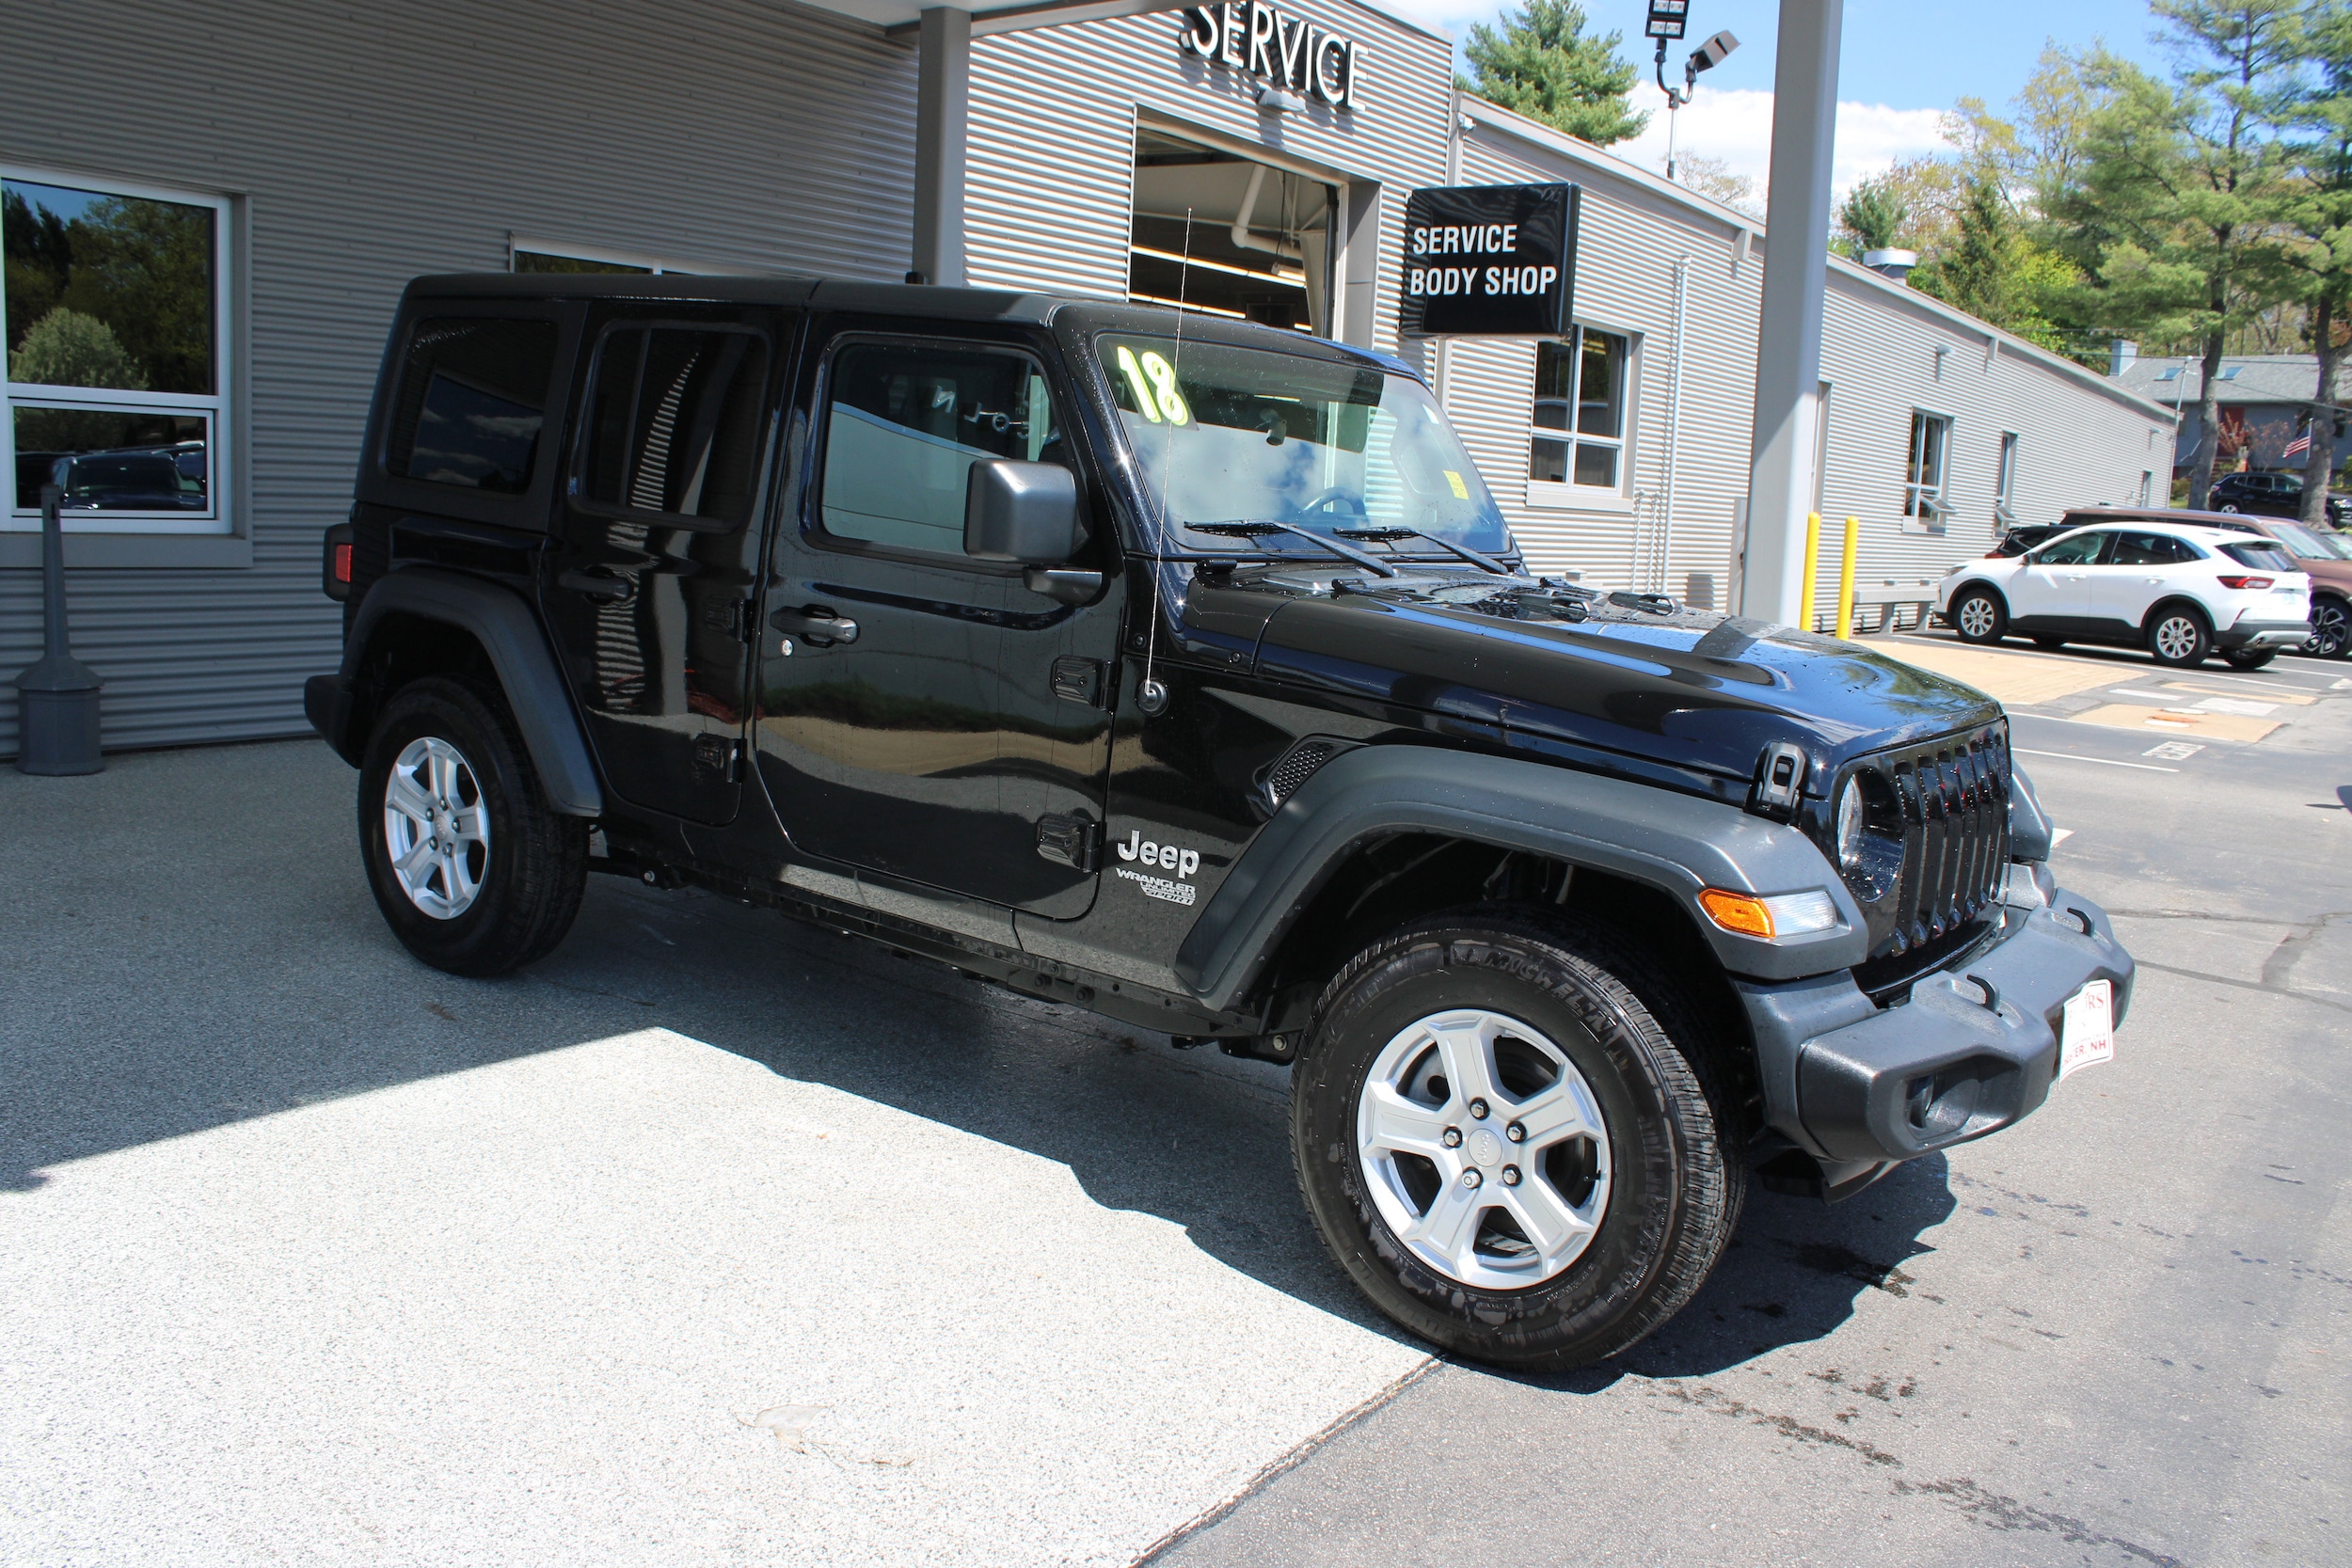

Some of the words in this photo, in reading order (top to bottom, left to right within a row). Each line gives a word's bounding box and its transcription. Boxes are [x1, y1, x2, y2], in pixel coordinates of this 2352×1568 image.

[1185, 1, 1369, 112] SERVICE
[1413, 224, 1518, 255] SERVICE
[1409, 267, 1478, 296] BODY
[1485, 265, 1557, 295] SHOP
[1117, 345, 1188, 426] 18
[1117, 830, 1200, 879] Jeep
[1116, 867, 1196, 894] WRANGLER
[1140, 881, 1196, 898] UNLIMITED
[1144, 888, 1194, 904] SPORT
[2090, 1039, 2106, 1053] NH
